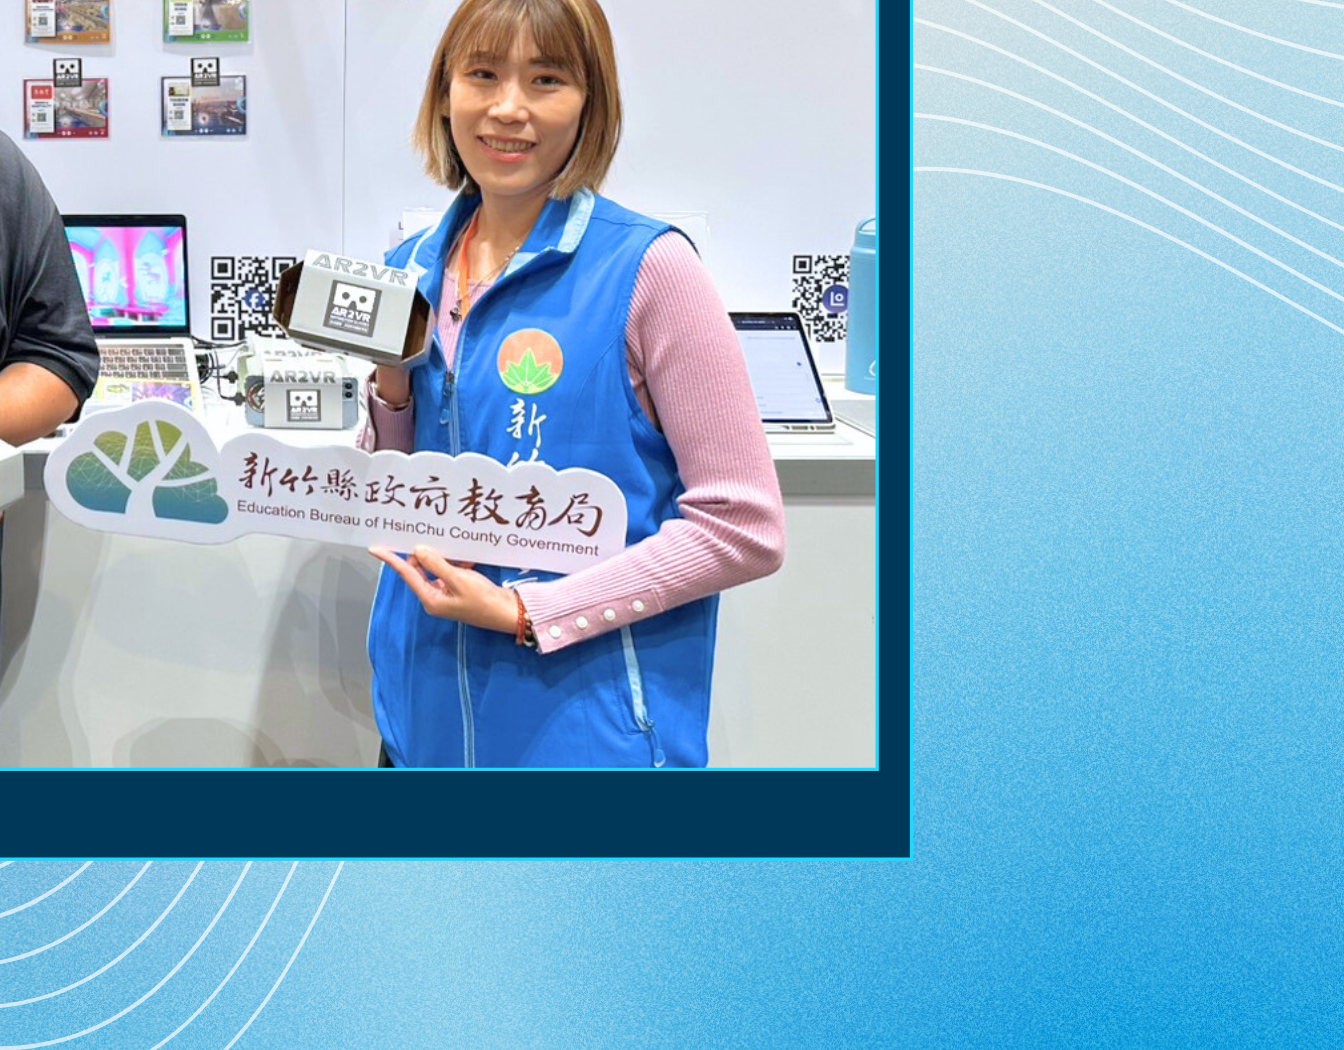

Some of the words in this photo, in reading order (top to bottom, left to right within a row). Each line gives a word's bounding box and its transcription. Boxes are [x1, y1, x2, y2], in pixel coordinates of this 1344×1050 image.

[312, 253, 409, 287] AR2VR
[331, 306, 371, 323] AR2VR
[270, 369, 336, 384] AR2VR
[238, 451, 604, 538] 新竹縣政府教育局
[237, 499, 306, 520] Education
[310, 509, 361, 528] Bureau
[364, 513, 380, 529] of
[382, 518, 445, 537] HsinChu
[449, 525, 502, 547] County
[506, 532, 600, 557] Government
